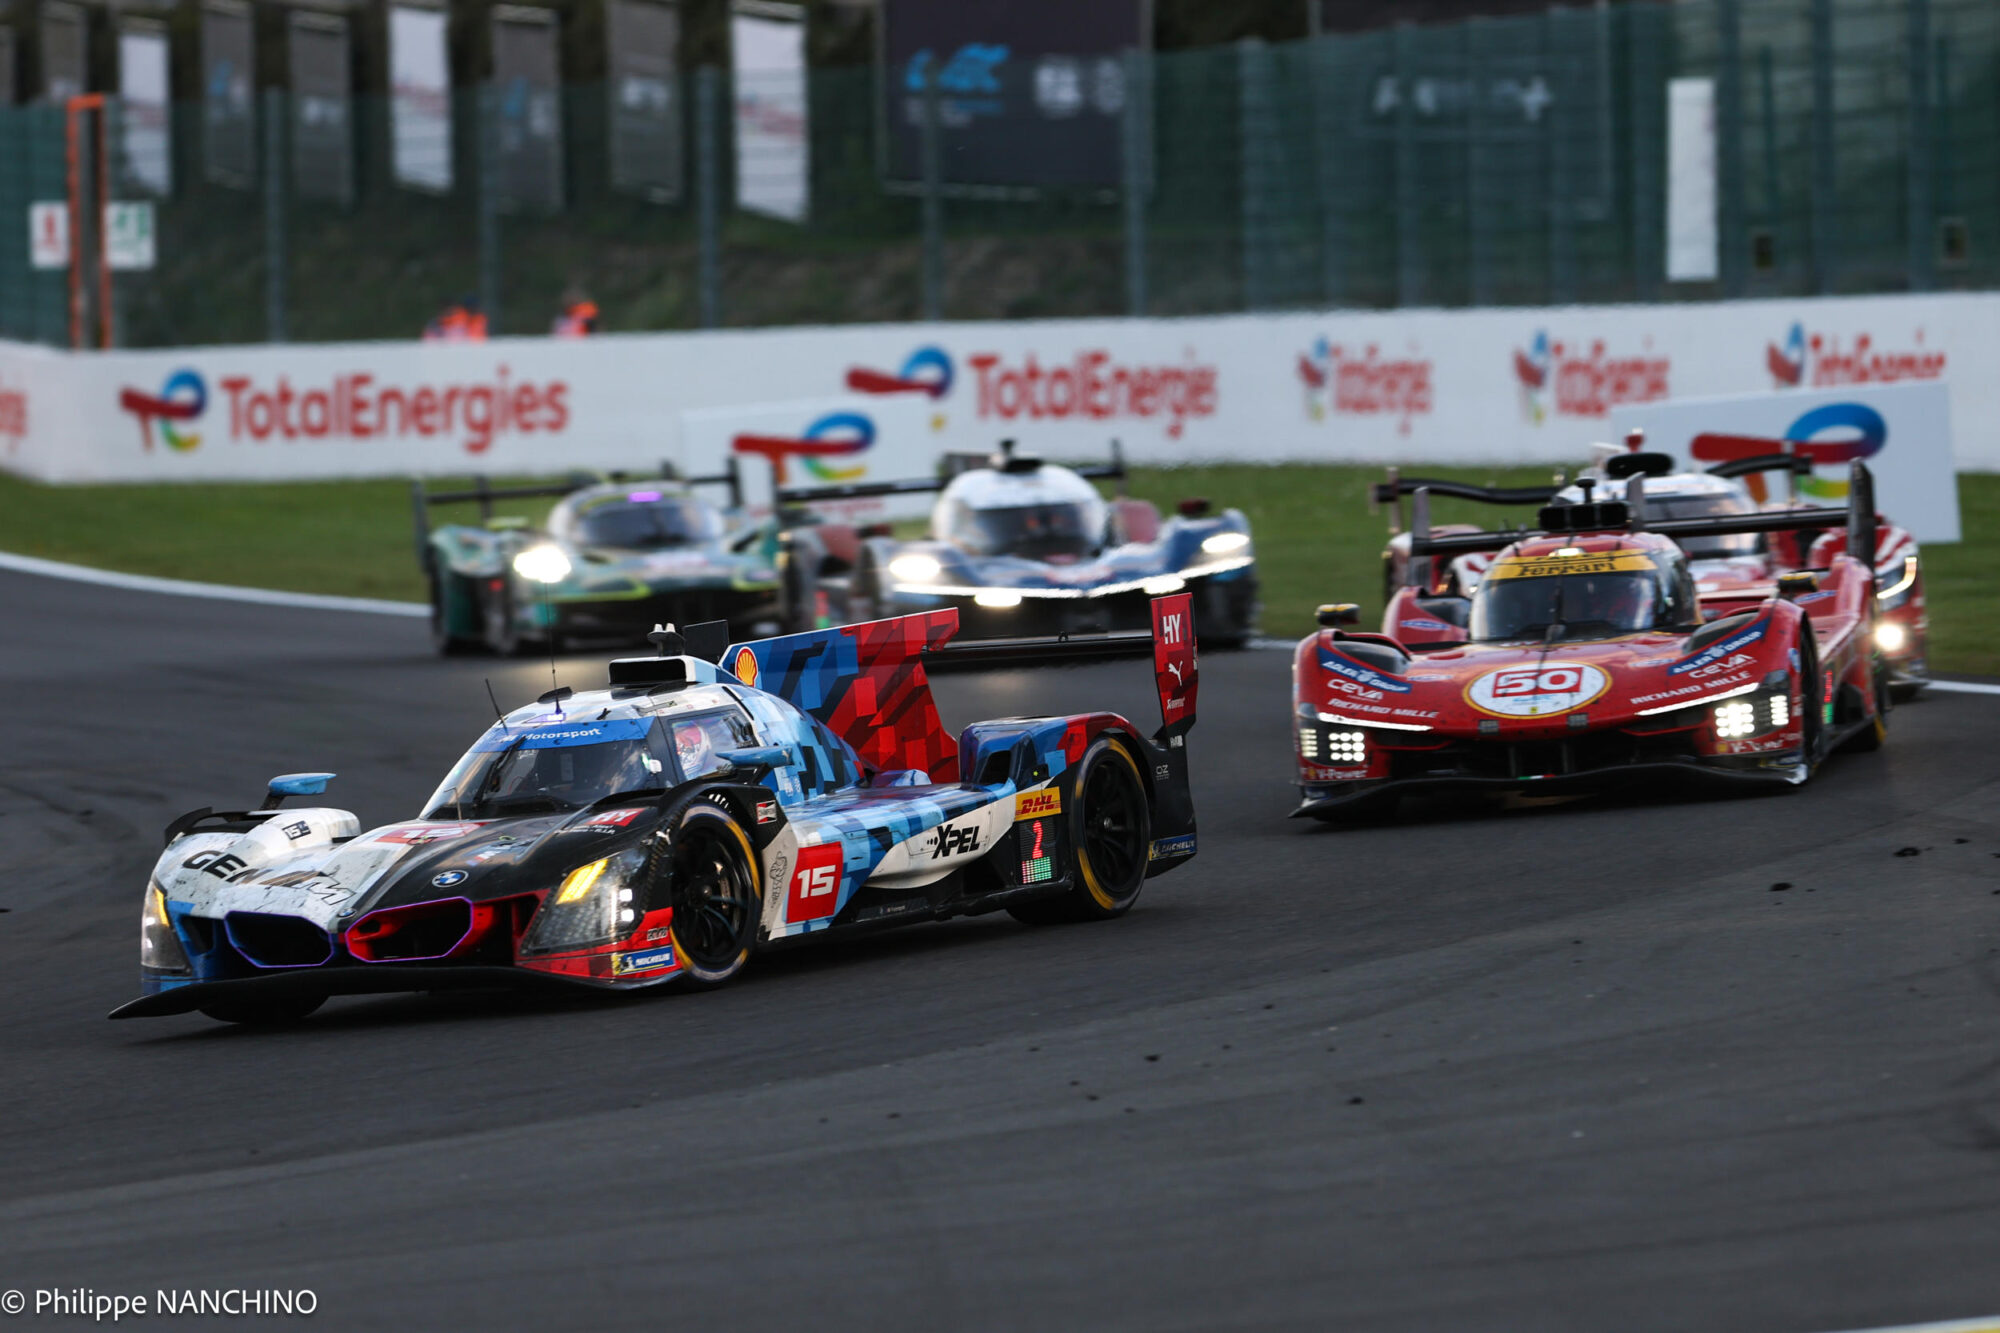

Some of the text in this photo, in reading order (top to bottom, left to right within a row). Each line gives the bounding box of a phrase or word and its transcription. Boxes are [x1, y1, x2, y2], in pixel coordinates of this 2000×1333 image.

[221, 366, 569, 453] TotalEnergies
[1163, 613, 1181, 644] HY
[1496, 670, 1580, 694] 50
[1630, 670, 1752, 704] RICHARD MILLE
[1328, 698, 1391, 714] RICHARD
[1391, 708, 1439, 718] MILLE
[1020, 794, 1053, 815] DHL
[931, 823, 981, 860] XPEL
[797, 864, 837, 899] 15
